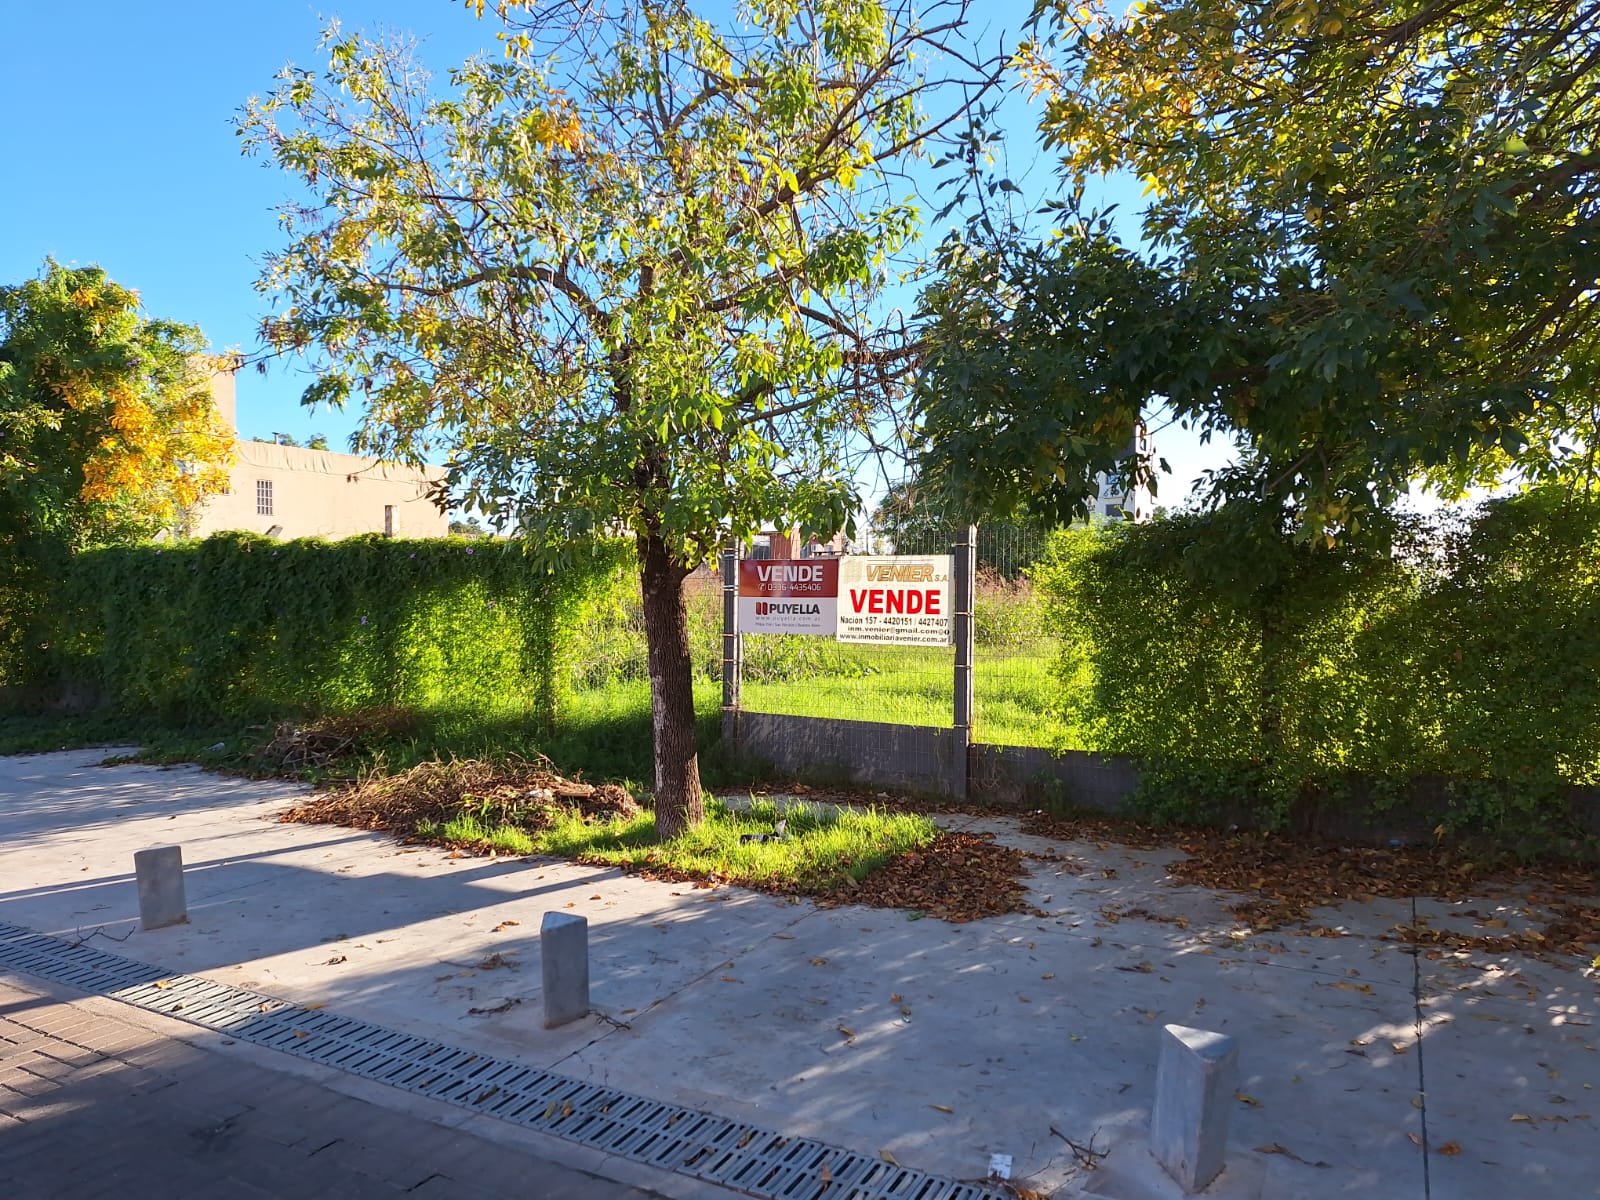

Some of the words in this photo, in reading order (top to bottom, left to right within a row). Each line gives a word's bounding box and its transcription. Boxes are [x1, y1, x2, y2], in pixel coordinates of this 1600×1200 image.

[757, 565, 823, 582] VENDE
[866, 565, 934, 582] VENIER
[769, 603, 820, 614] PUYELLA
[850, 589, 941, 614] VENDE
[865, 616, 877, 624] 157
[883, 617, 912, 626] 4420151
[918, 618, 948, 627] 4427407
[840, 633, 947, 643] www.inmobiliariavenier.com.ar
